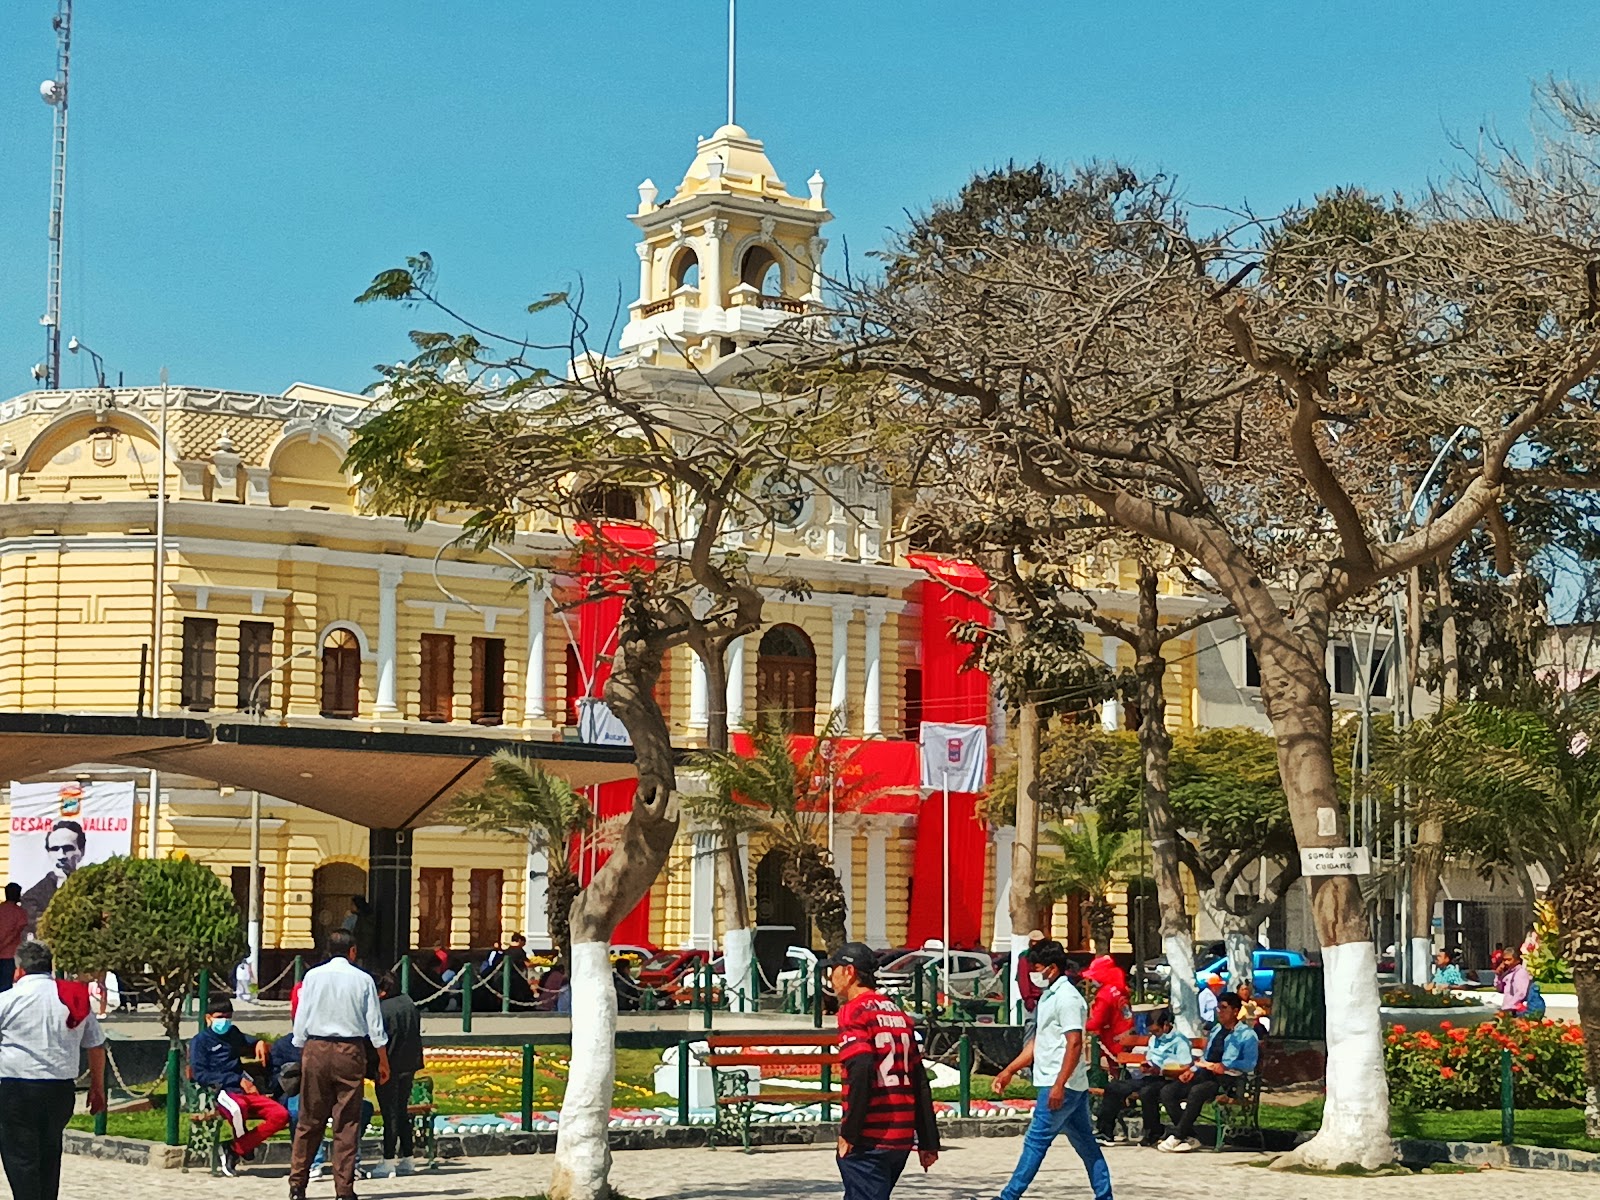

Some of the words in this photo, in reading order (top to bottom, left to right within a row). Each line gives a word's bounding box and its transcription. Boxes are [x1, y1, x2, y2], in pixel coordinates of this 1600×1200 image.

[12, 817, 54, 832] CESAR
[82, 817, 128, 832] VALLEJO
[875, 1032, 910, 1087] 21
